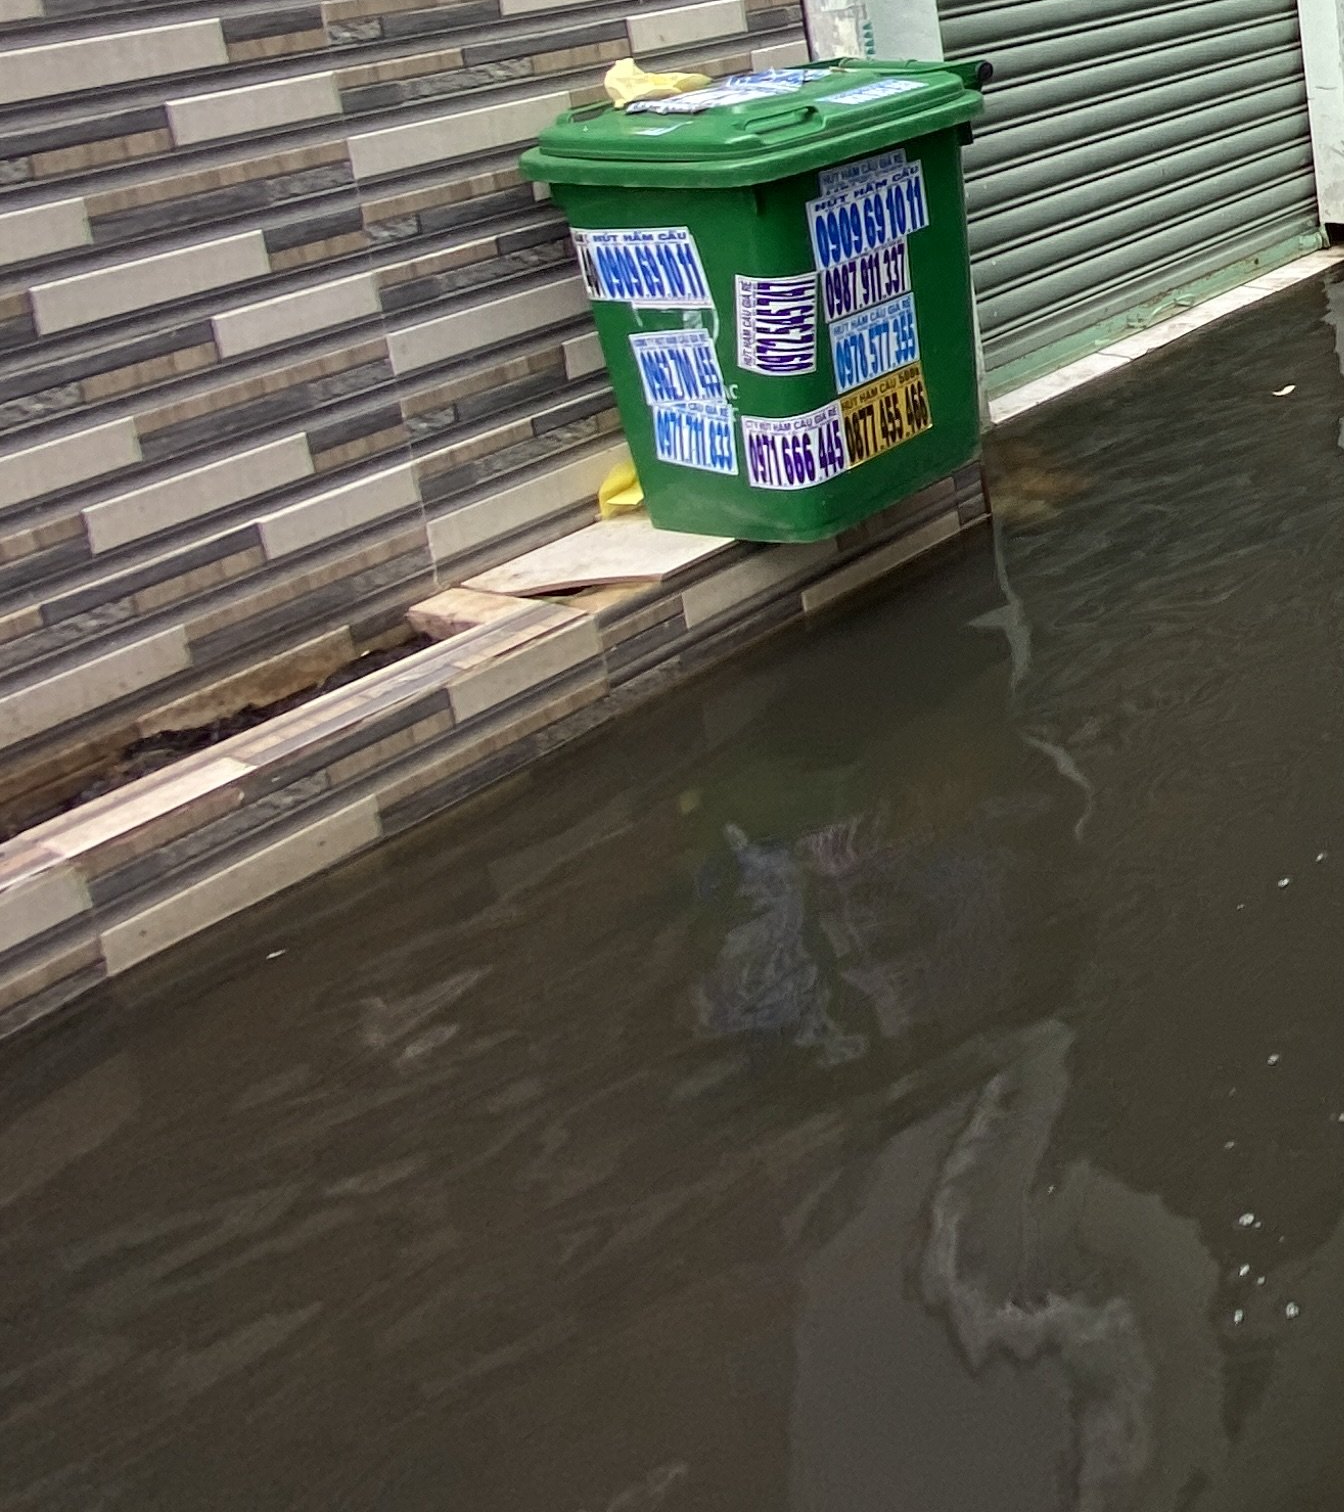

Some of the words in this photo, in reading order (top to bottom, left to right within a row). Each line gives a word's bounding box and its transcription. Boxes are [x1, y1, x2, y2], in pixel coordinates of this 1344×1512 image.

[815, 175, 925, 269] 0909.69.10.11
[824, 242, 906, 320] 0987.911.337
[748, 419, 845, 486] 0971.666.445
